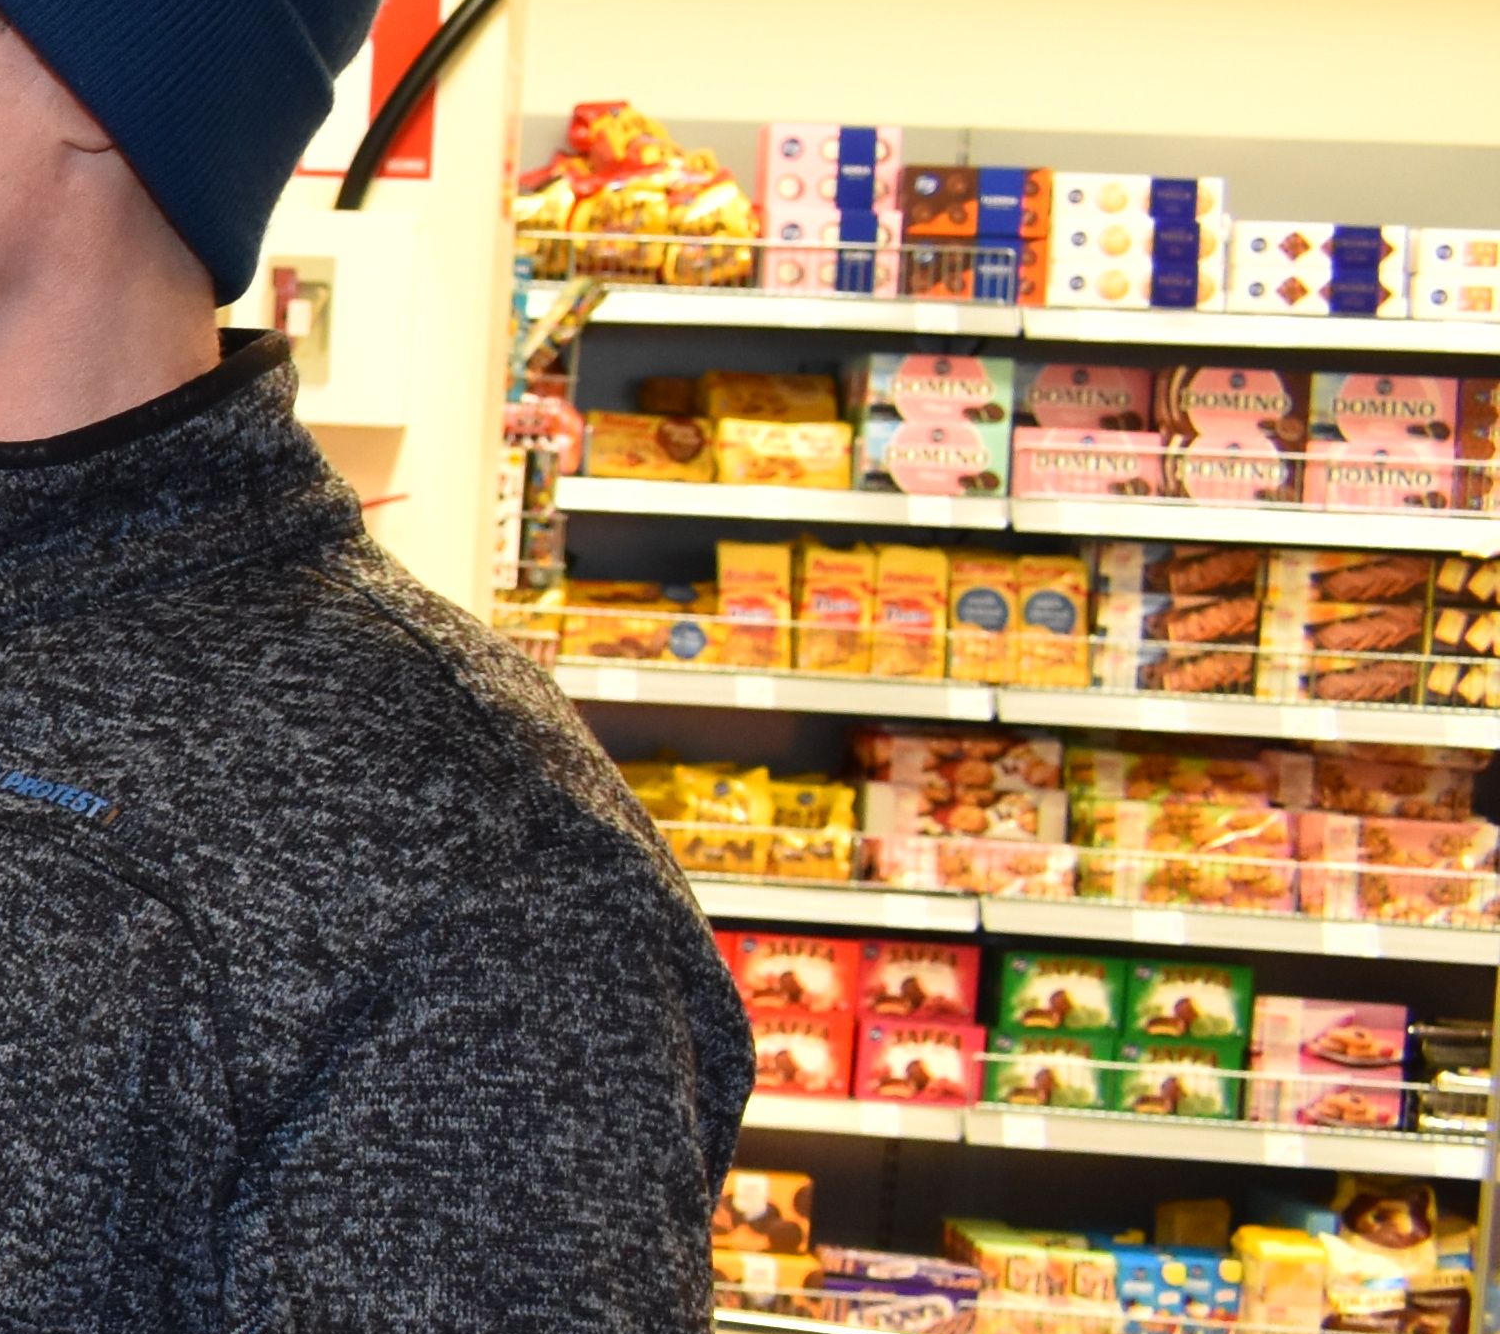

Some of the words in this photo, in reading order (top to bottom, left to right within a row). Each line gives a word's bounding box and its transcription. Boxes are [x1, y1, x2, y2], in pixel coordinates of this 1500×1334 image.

[892, 377, 994, 399] DOMINO
[1029, 387, 1133, 409] DOMINO
[1184, 393, 1292, 413] DOMINO
[1332, 398, 1436, 419] DOMINO
[885, 448, 989, 467] DOMINO
[1036, 452, 1137, 475] DOMINO
[1180, 461, 1287, 484] DOMINO
[1326, 467, 1431, 490] DOMINO
[0, 770, 109, 818] PROTEST
[894, 1029, 963, 1049] JAFFA
